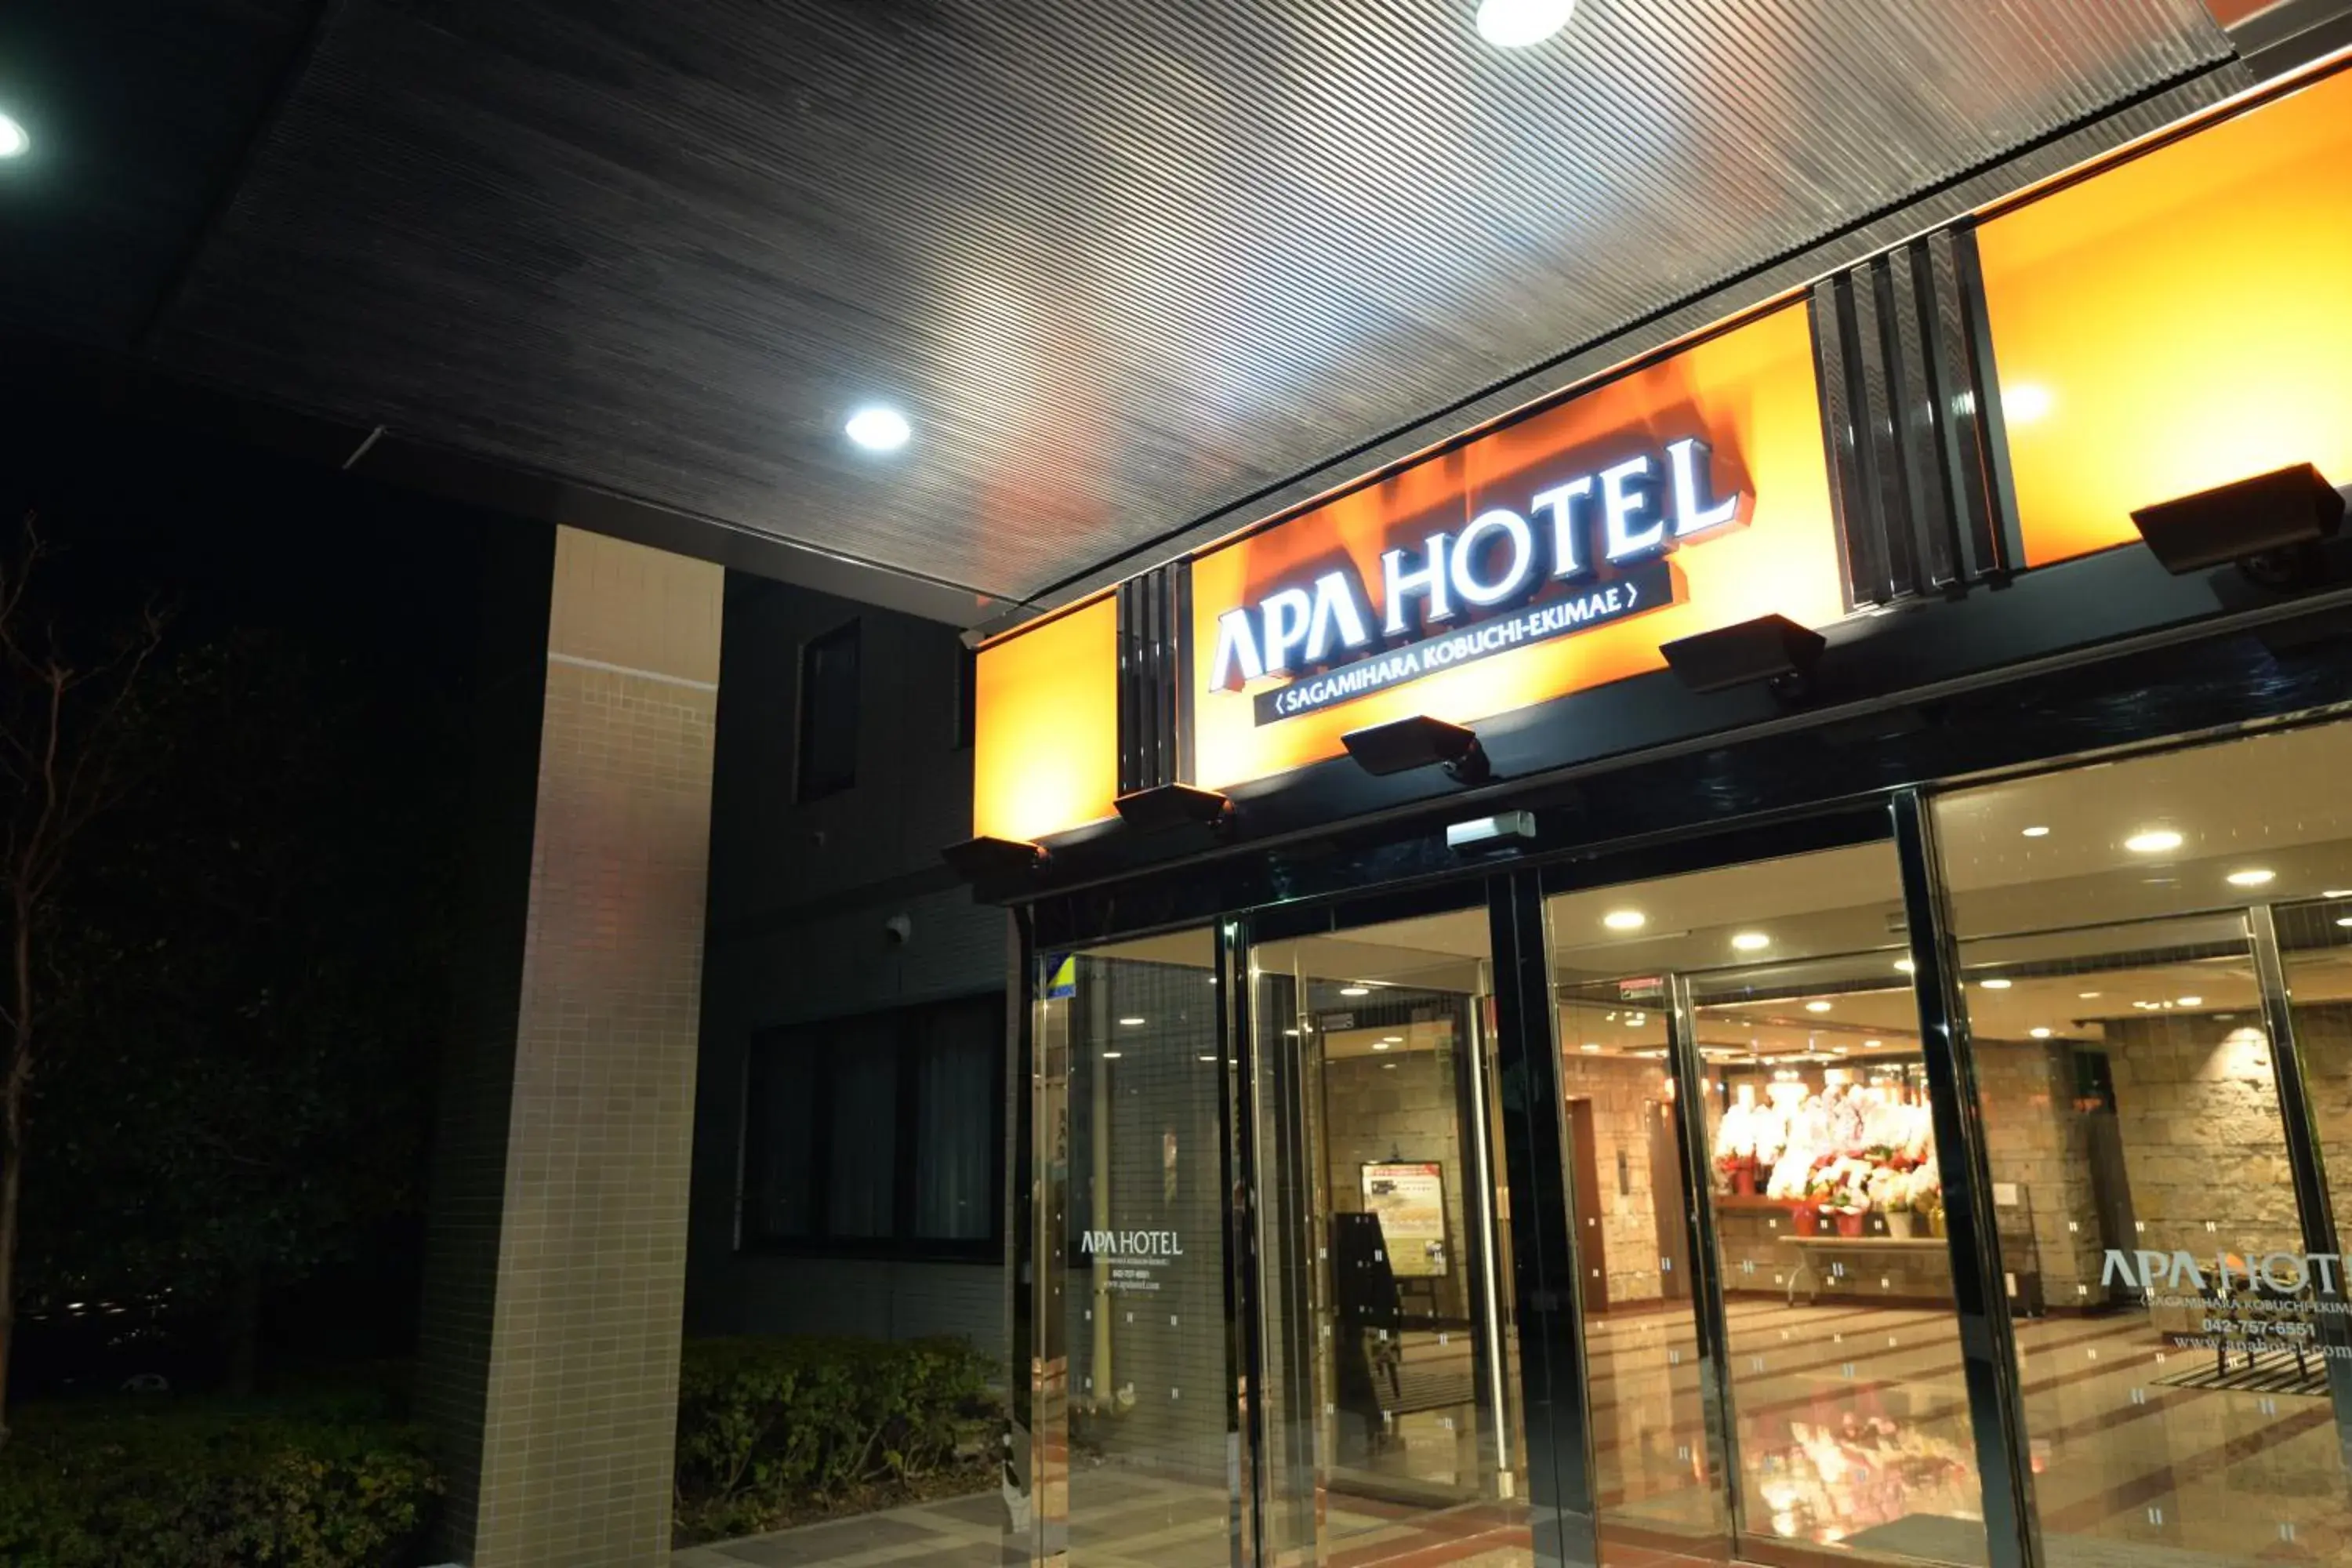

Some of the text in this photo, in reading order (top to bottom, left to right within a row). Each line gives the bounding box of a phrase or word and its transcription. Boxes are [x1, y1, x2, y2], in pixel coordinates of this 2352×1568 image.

[1210, 437, 1739, 692] APA HOTEL
[1081, 1231, 1184, 1255] APA HOTEL
[2101, 1249, 2352, 1294] APA HOT
[2202, 1318, 2316, 1338] 042-757-6551
